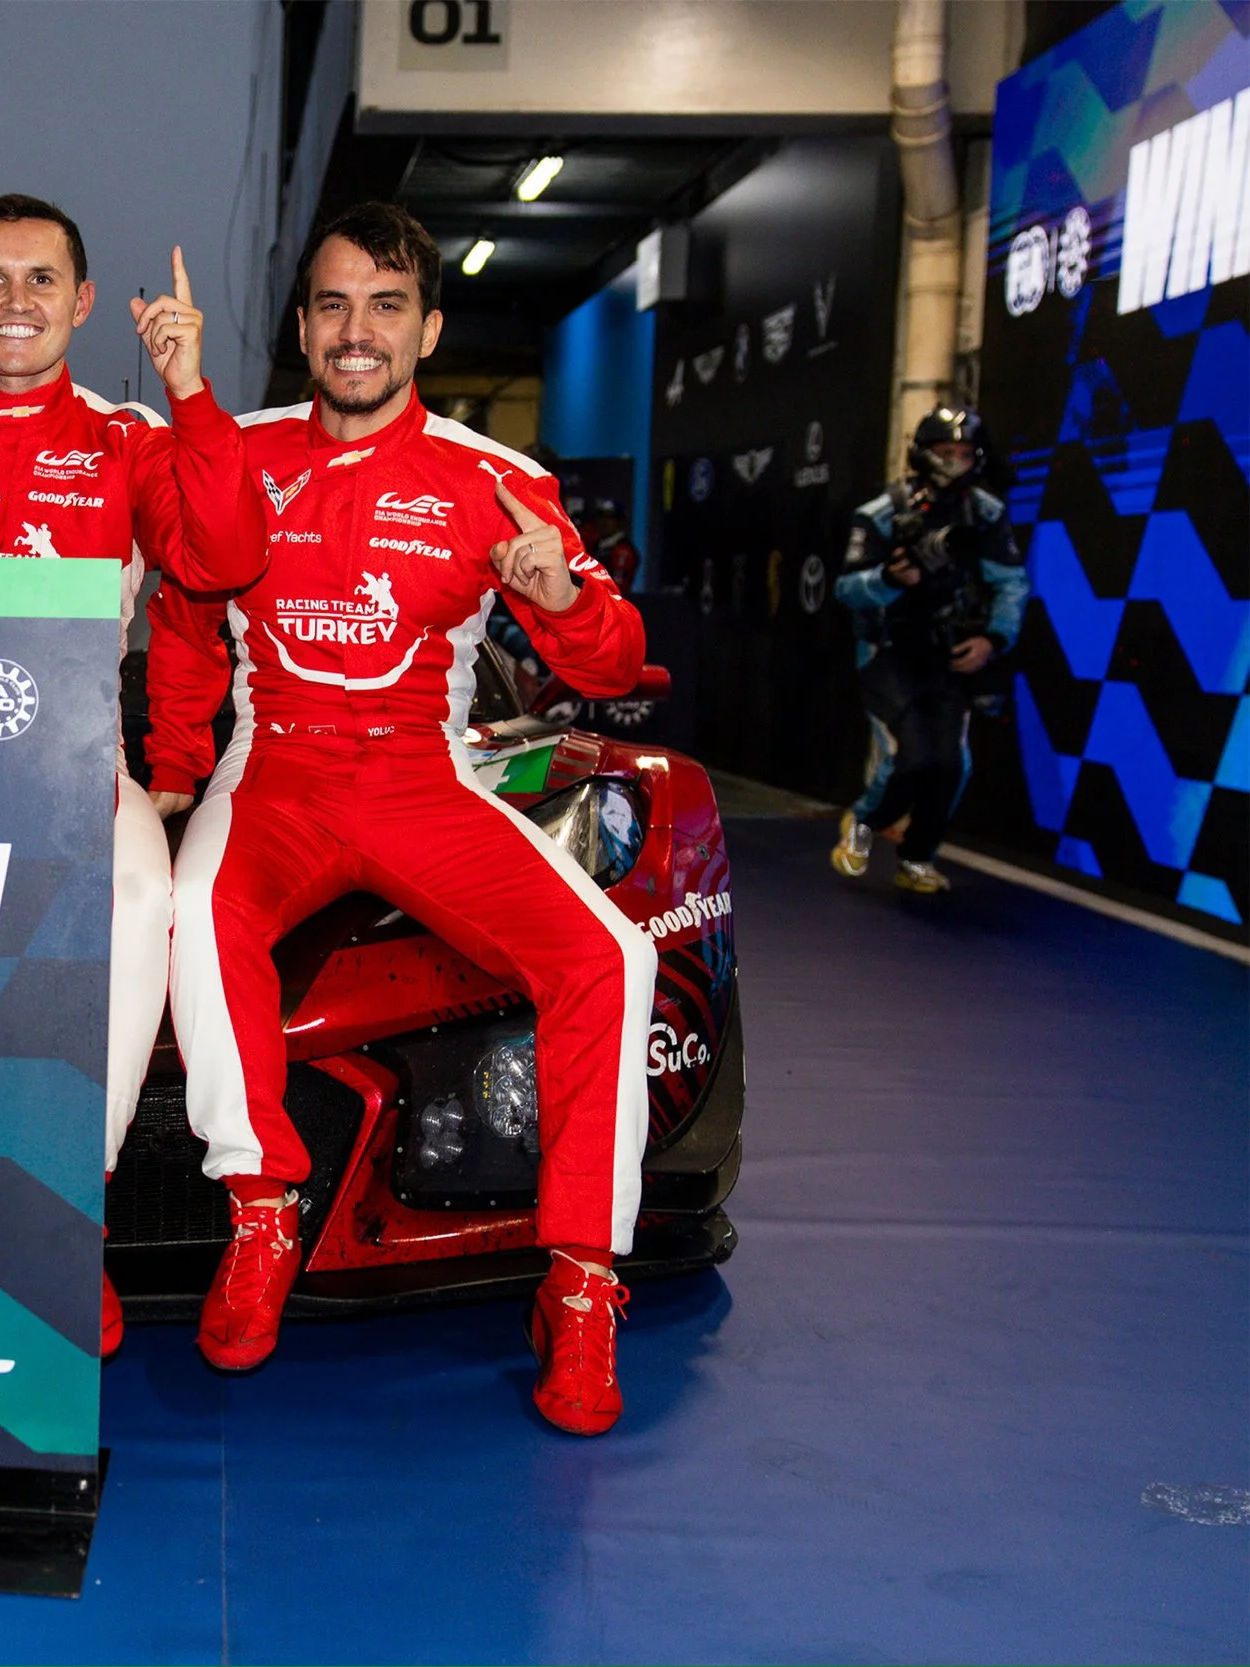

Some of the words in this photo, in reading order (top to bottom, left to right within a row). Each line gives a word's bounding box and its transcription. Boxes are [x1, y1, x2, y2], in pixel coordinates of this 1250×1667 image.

[409, 0, 501, 45] 01
[1116, 86, 1250, 316] WIN
[35, 449, 105, 471] WEC
[28, 490, 105, 508] GOODYEAR
[375, 491, 455, 517] WEC
[285, 531, 322, 543] Yachts
[369, 537, 453, 561] GOODYEAR
[276, 598, 329, 611] RACING
[330, 600, 375, 615] TEAM
[277, 618, 398, 645] TURKEY
